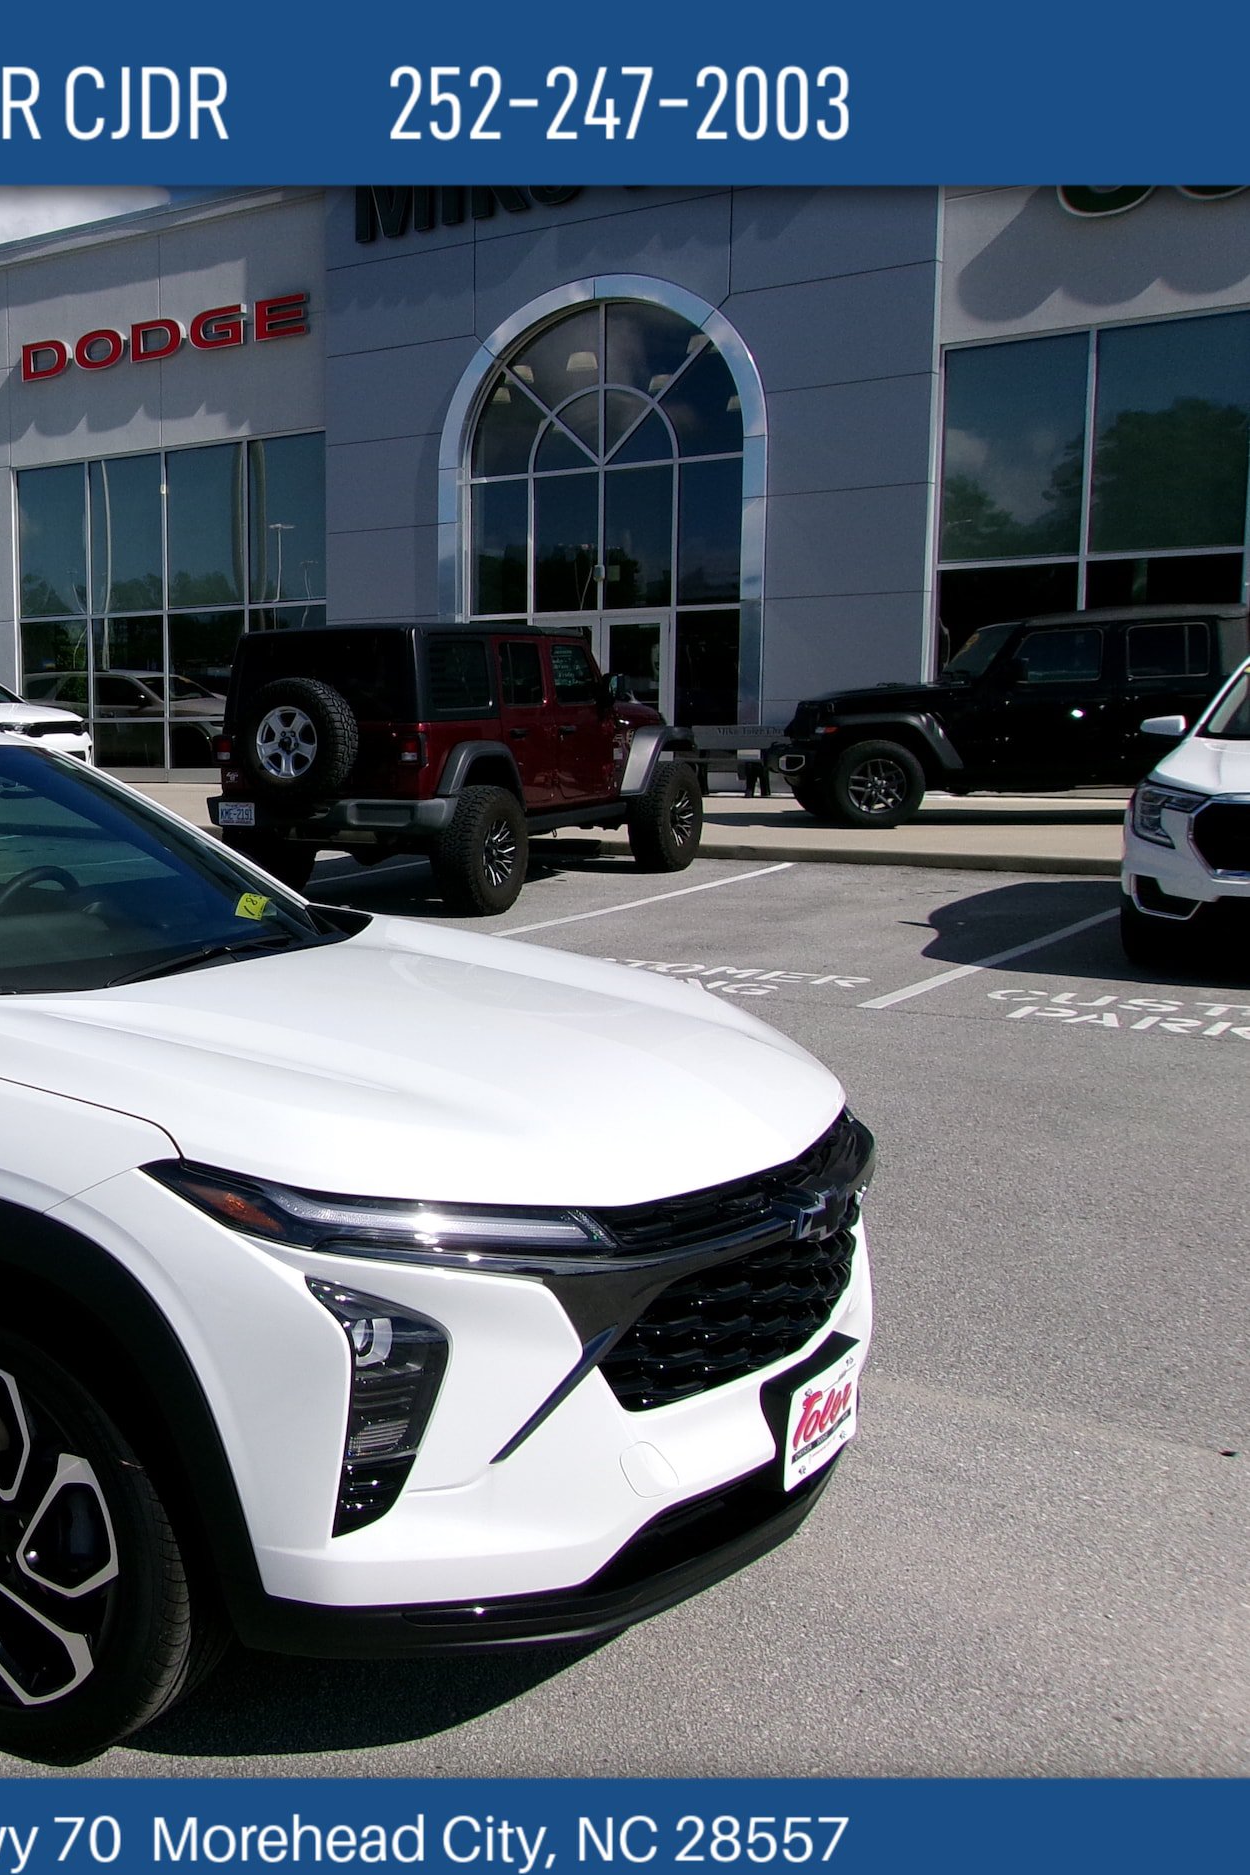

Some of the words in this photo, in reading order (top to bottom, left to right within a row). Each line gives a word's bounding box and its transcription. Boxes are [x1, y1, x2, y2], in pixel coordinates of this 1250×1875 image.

[21, 292, 310, 383] DODGE
[987, 989, 1250, 1016] CUST
[793, 1381, 853, 1451] Toler
